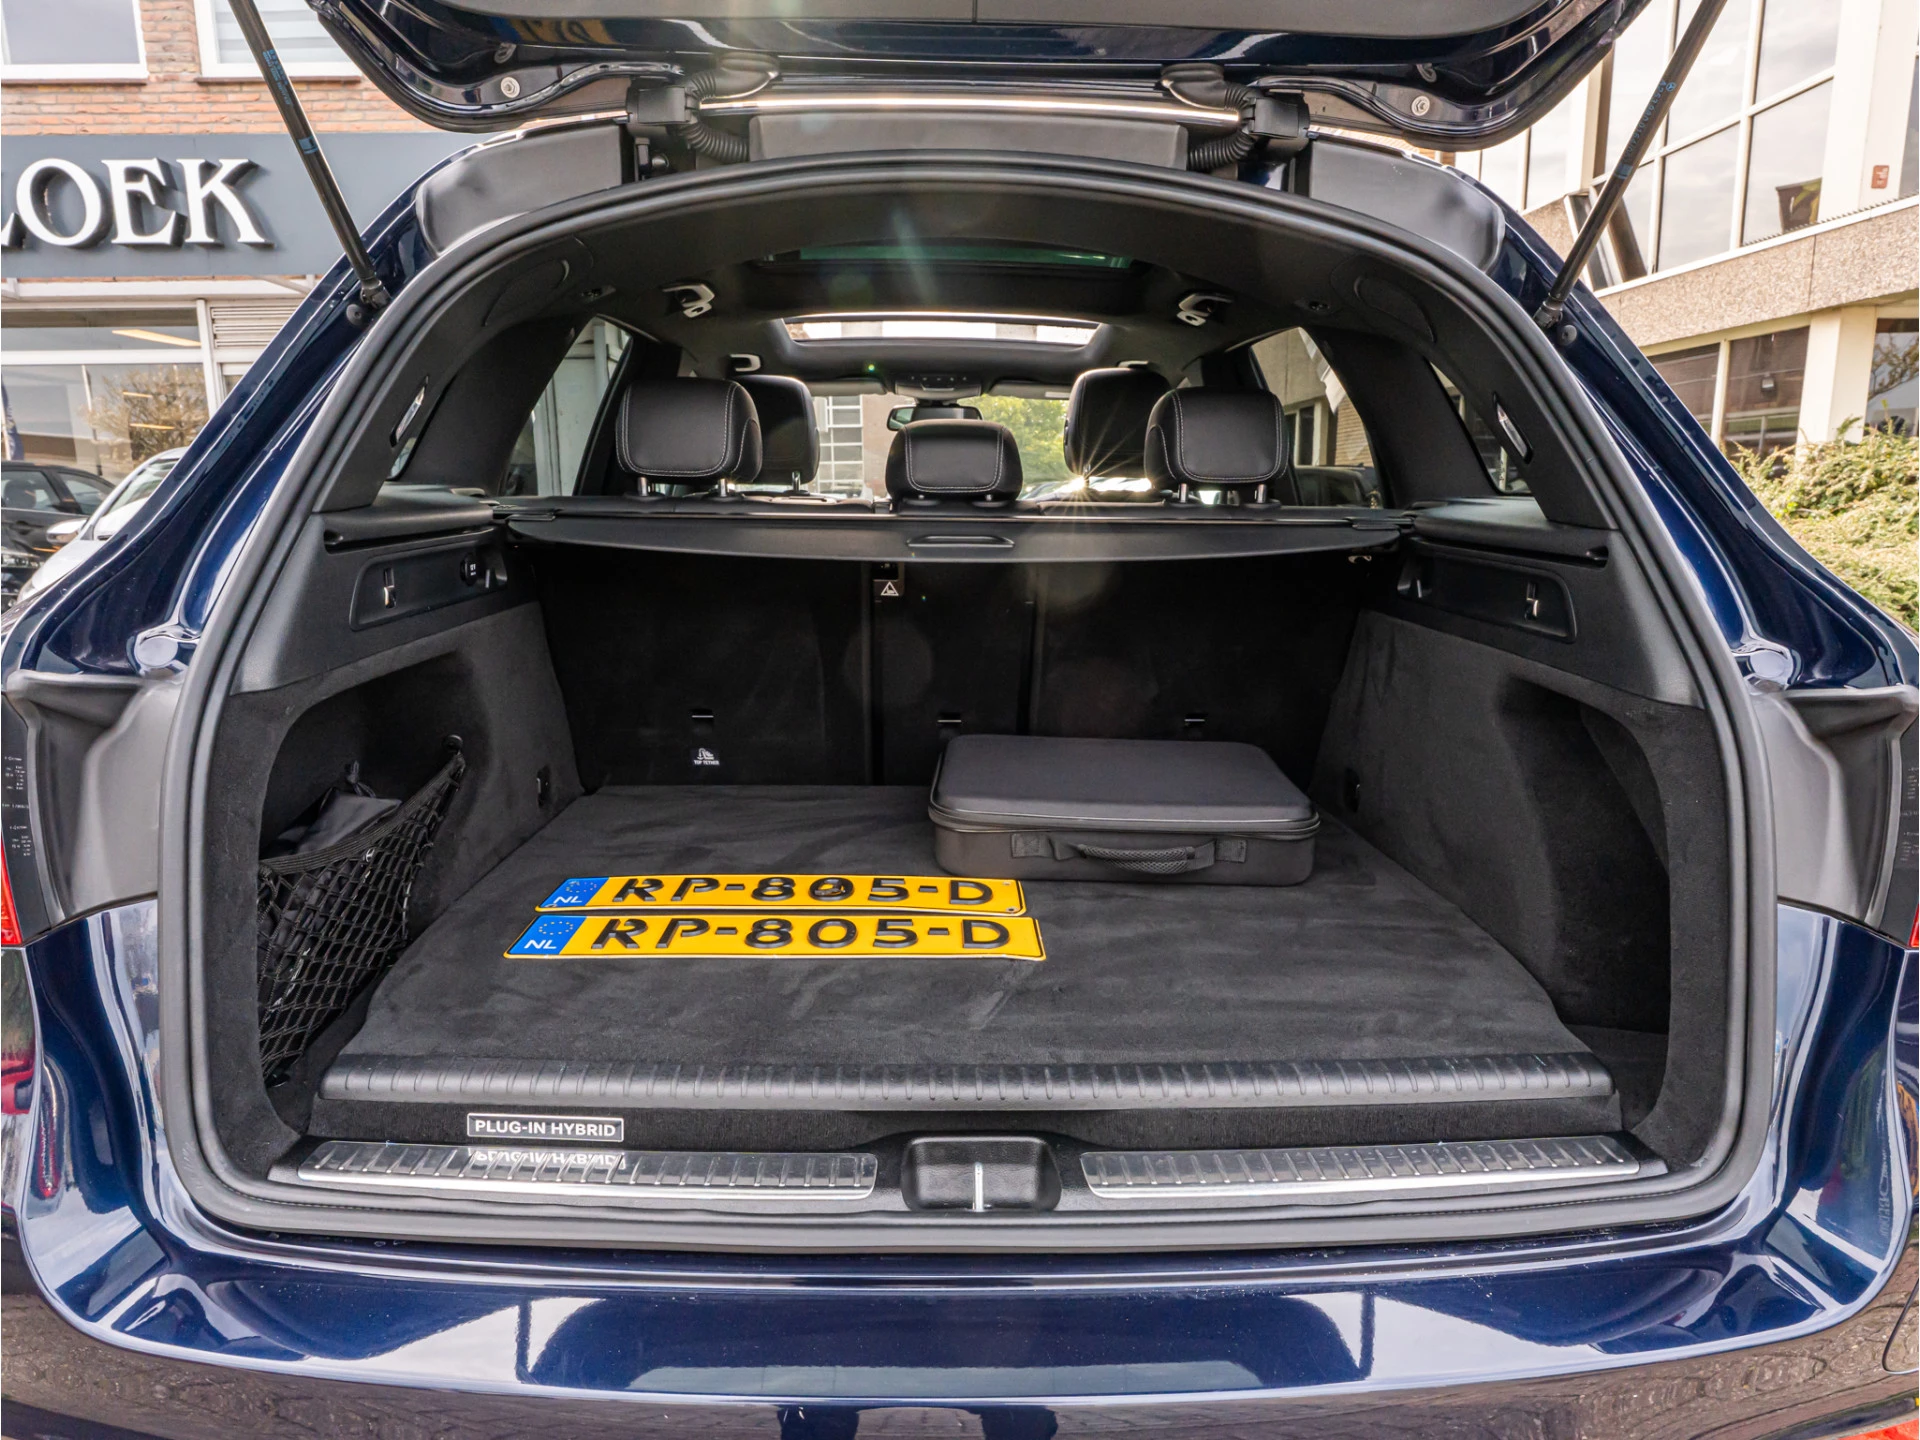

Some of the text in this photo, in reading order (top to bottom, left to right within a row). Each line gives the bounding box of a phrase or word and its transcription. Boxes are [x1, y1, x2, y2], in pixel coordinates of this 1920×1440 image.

[553, 877, 993, 905] NL RP-805-D
[524, 918, 1010, 949] NL RP-805-D
[475, 1120, 616, 1137] PLUG-IN HYBRID
